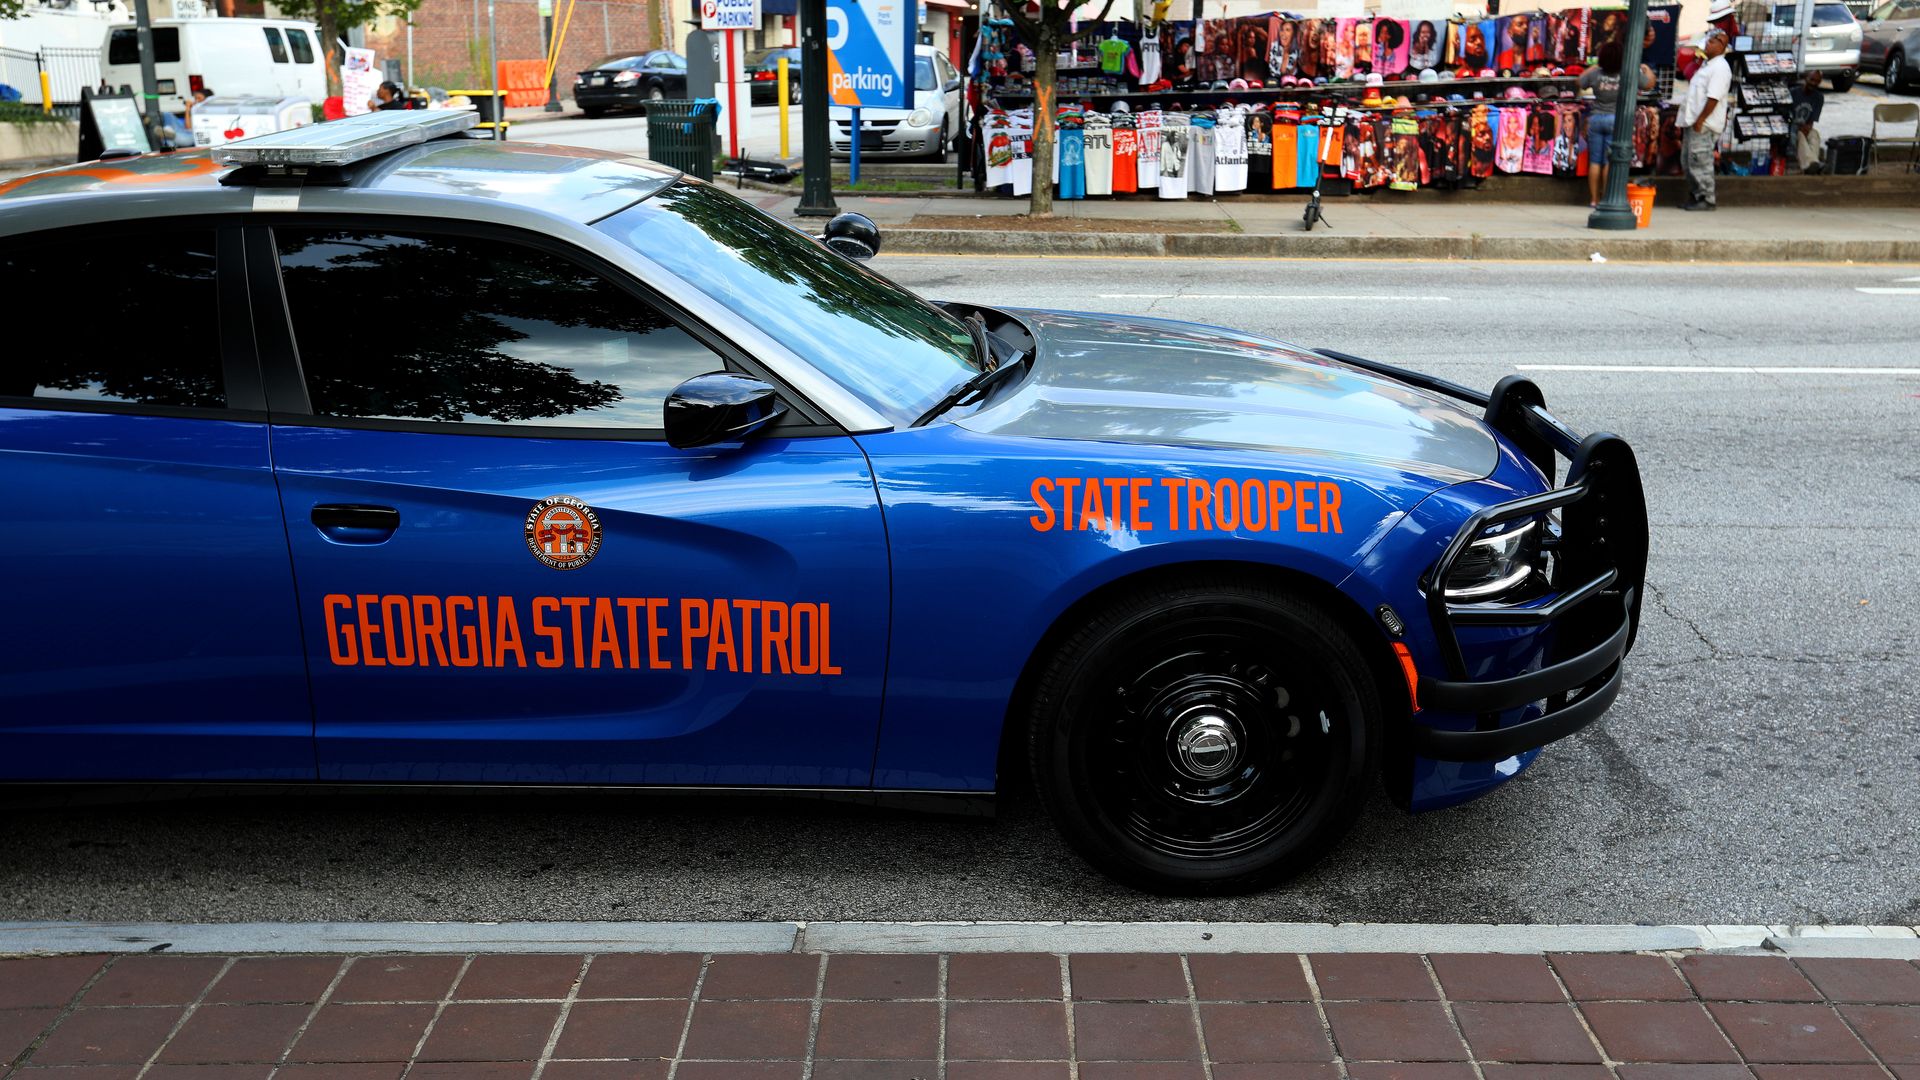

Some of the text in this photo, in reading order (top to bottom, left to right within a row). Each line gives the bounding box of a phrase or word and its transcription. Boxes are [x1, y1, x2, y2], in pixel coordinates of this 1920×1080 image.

[717, 11, 753, 26] PARKING
[832, 65, 893, 97] parking
[1083, 134, 1112, 149] ATL
[1214, 156, 1248, 165] Atlanta
[527, 497, 600, 530] STATE OF GEORGIA
[545, 507, 578, 520] CONSTITUTION
[1029, 477, 1344, 534] STATE TROOPER
[528, 537, 557, 566] DEPARTMENT
[567, 556, 588, 568] PUBLIC
[586, 536, 600, 557] SAFETY
[322, 593, 842, 675] GEORGIA STATE PATROL
